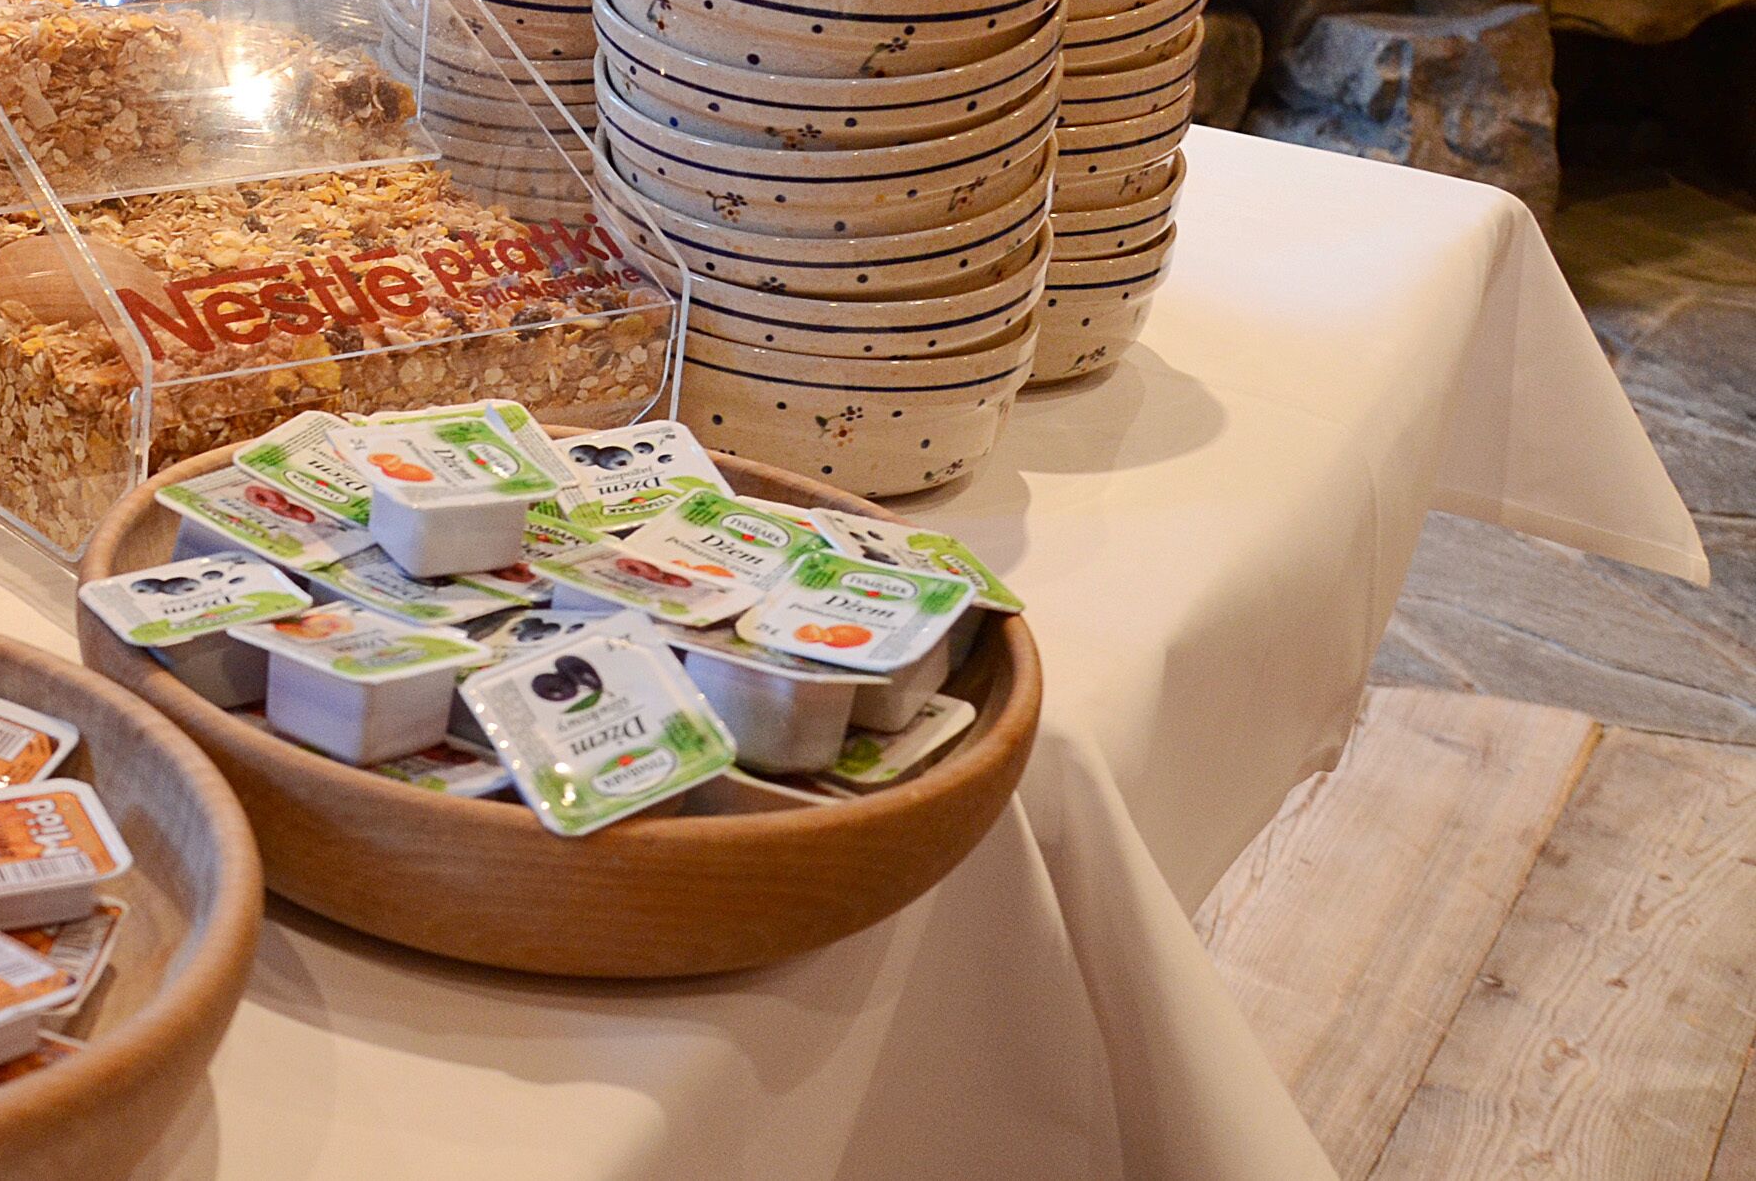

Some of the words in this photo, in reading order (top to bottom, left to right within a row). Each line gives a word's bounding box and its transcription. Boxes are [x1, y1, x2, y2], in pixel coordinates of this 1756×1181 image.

[422, 212, 624, 299] płatki
[598, 476, 662, 496] Dżem
[701, 534, 765, 566] Dżem
[824, 594, 897, 620] Dżem
[570, 715, 647, 756] Dżem
[15, 798, 81, 859] Miód
